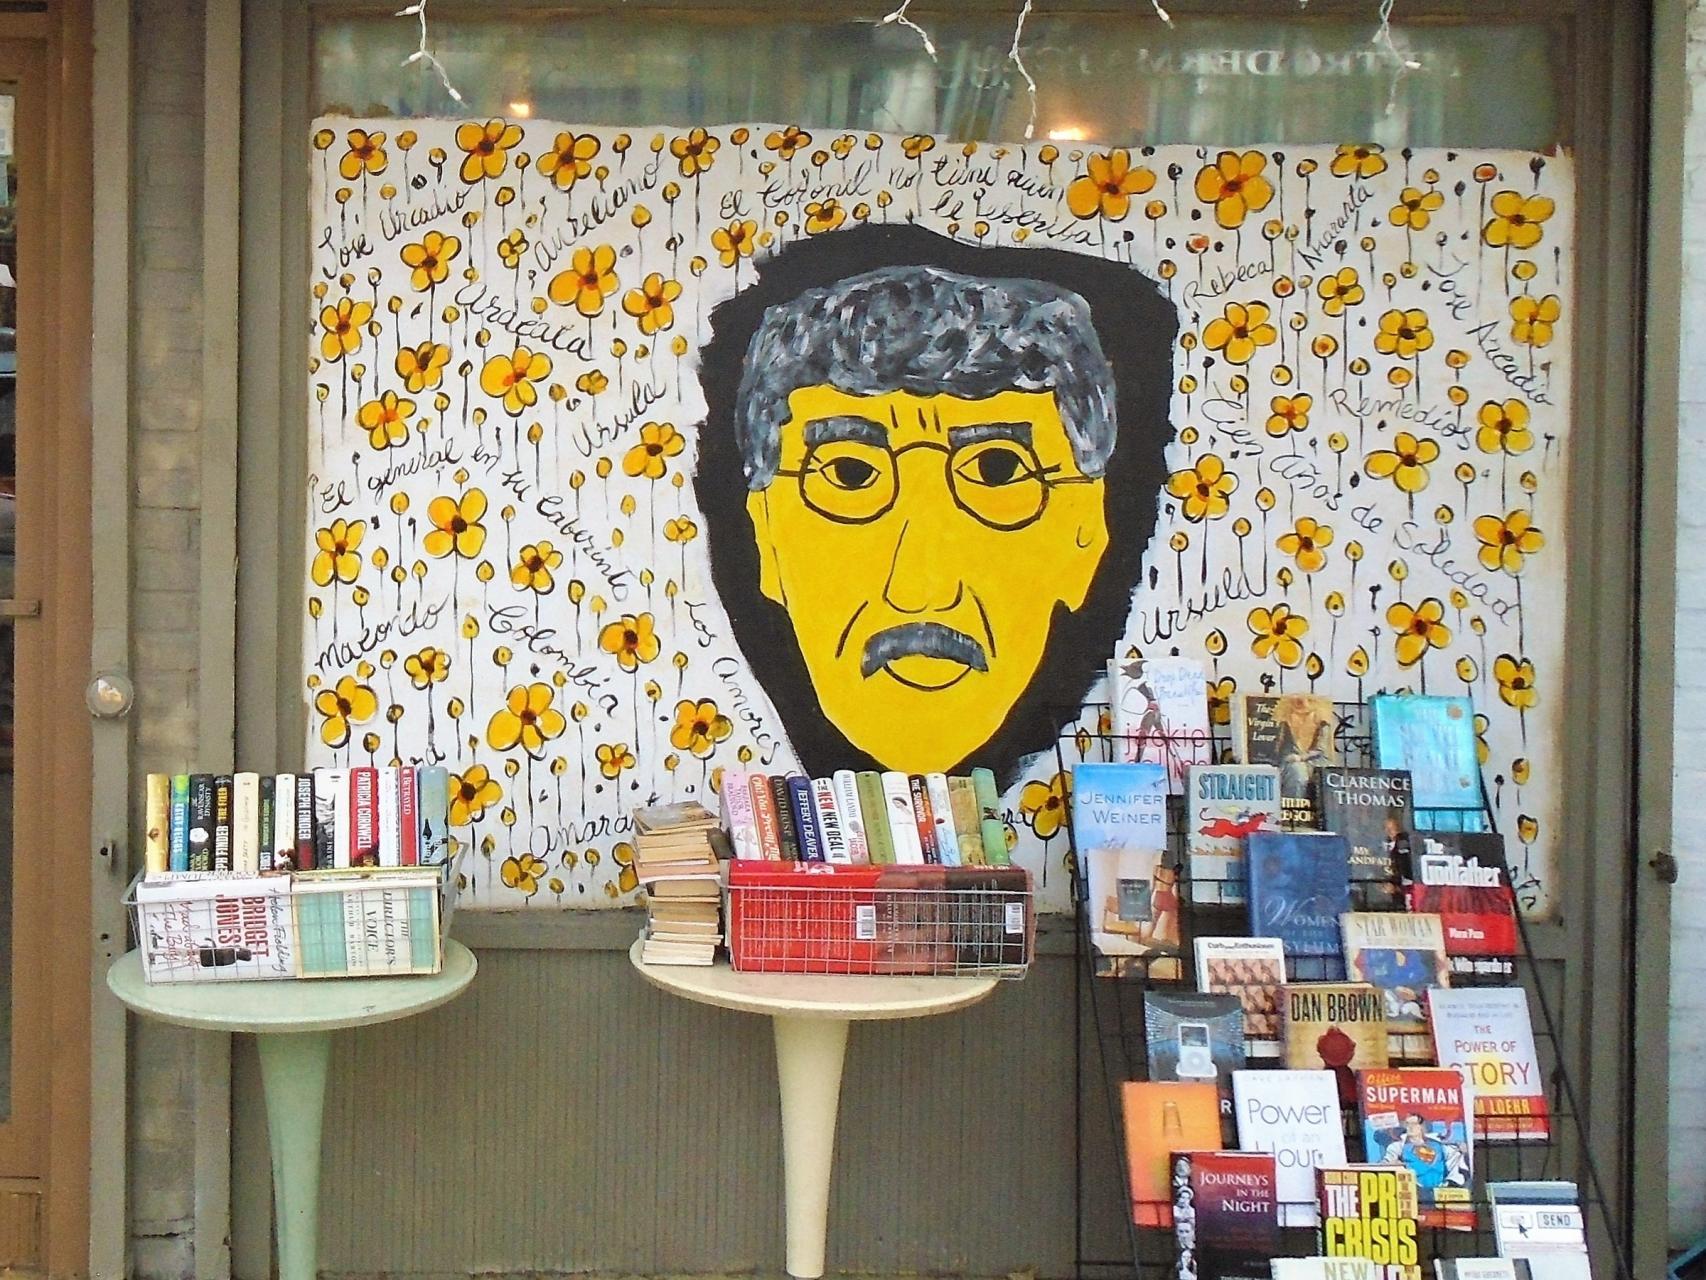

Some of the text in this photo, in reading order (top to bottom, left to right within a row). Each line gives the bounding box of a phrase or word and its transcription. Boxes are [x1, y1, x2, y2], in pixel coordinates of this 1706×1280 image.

[1184, 259, 1270, 309] Rebeca
[356, 771, 372, 807] PATRICIA
[774, 779, 785, 807] DAVID
[910, 779, 921, 791] THE
[1199, 771, 1276, 802] STRAIGHT
[1326, 773, 1411, 792] CLARENCE
[298, 777, 312, 840] JOSEPH FINDER
[817, 791, 834, 810] NEW
[1335, 790, 1406, 808] THOMAS
[357, 808, 372, 850] CORNWELL
[797, 789, 819, 859] JEFFERY DEAVER
[821, 810, 839, 829] NEW
[215, 825, 229, 856] FINDER
[826, 830, 845, 851] DEAL
[241, 896, 270, 958] BRIDGET
[365, 909, 379, 953] VOICE
[1283, 941, 1339, 954] SYLUM
[1290, 992, 1383, 1022] DAN BROWN
[1474, 1024, 1492, 1034] THE
[1501, 1040, 1518, 1053] OF
[1366, 1086, 1459, 1105] SUPERMAN
[1247, 1098, 1331, 1125] Power
[1200, 1171, 1269, 1186] JOURNEYS
[1236, 1188, 1269, 1198] IN THE
[1324, 1184, 1360, 1218] THE
[1222, 1199, 1270, 1213] NIGHT
[1543, 1214, 1571, 1226] SEND
[1325, 1217, 1418, 1266] CRISIS
